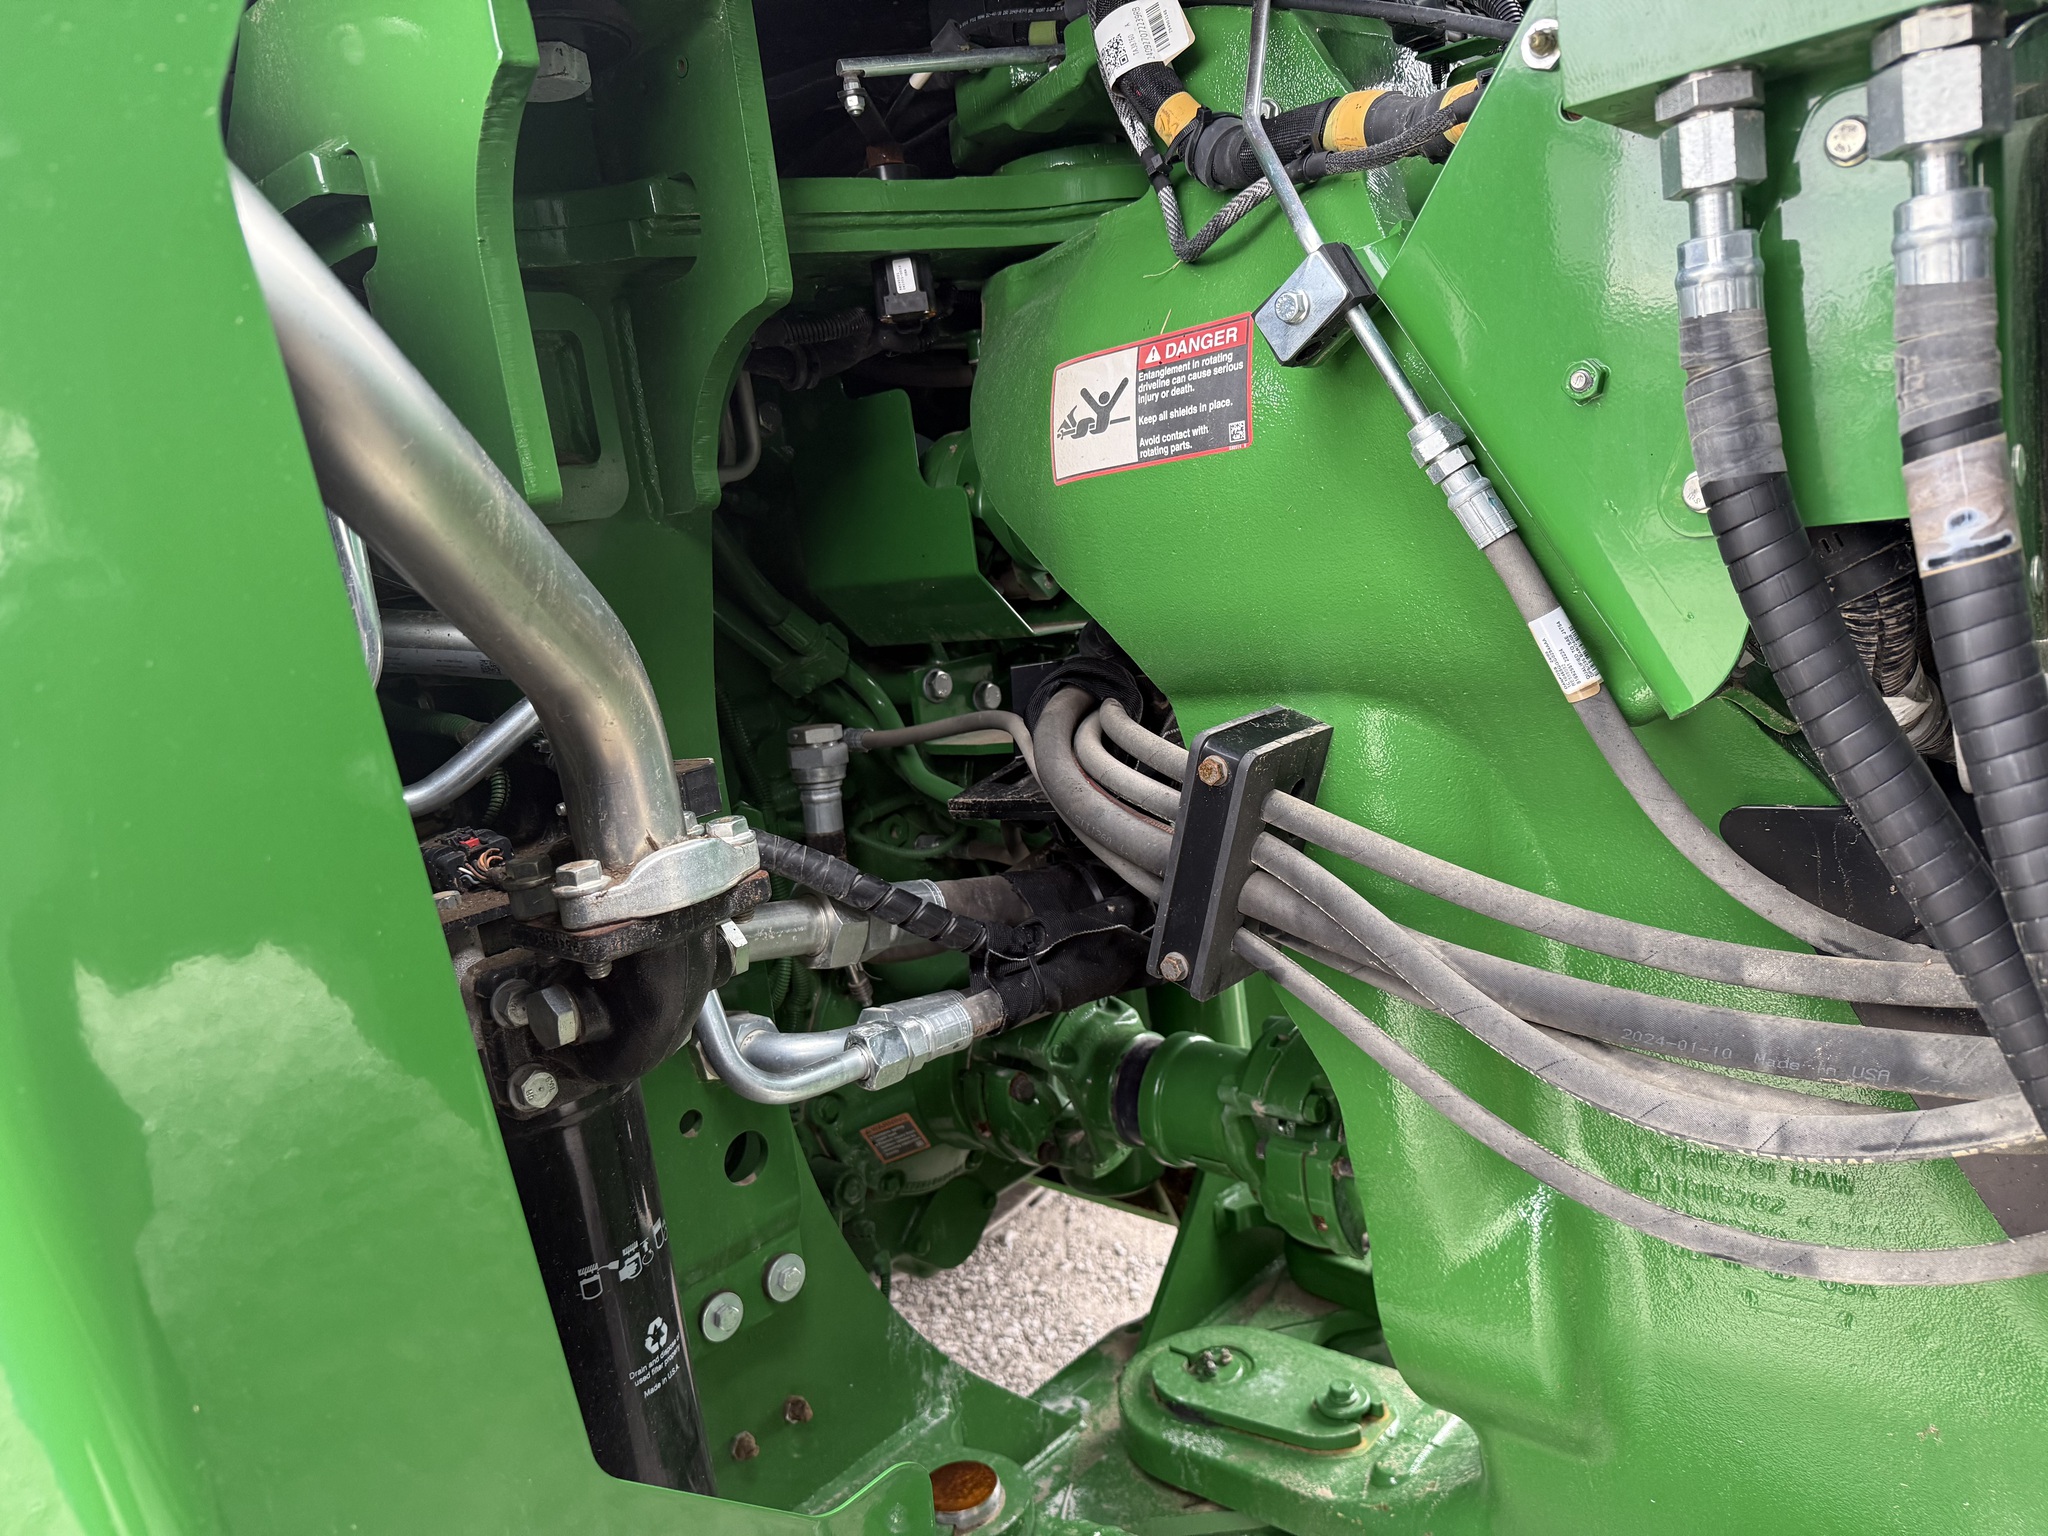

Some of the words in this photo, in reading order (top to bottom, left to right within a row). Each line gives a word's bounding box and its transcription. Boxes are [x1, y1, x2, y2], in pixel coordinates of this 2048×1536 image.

[1165, 327, 1237, 359] DANGER
[1138, 362, 1190, 382] Entanglement
[1192, 360, 1200, 370] in
[1201, 352, 1233, 369] rotating
[1138, 377, 1170, 393] driveline
[1172, 375, 1186, 387] can
[1187, 369, 1211, 382] cause
[1213, 361, 1243, 377] serious
[1138, 391, 1159, 404] injury
[1160, 390, 1168, 399] or
[1171, 384, 1195, 397] death.
[1138, 414, 1157, 425] Keep
[1159, 409, 1168, 421] all
[1169, 405, 1198, 419] shields
[1199, 402, 1207, 413] in
[1209, 398, 1233, 412] place.
[1139, 434, 1160, 447] Avoid
[1162, 429, 1190, 444] contact
[1192, 425, 1209, 438] with
[1139, 444, 1169, 459] rotating
[1170, 440, 1192, 455] parts.
[1574, 653, 1590, 680] QUALIFIED
[1621, 1028, 1732, 1060] 2024-01-10
[1754, 1052, 1800, 1072] Made
[1851, 1064, 1892, 1083] USA
[1790, 1166, 1855, 1196] RAW
[629, 1366, 647, 1379] Drain
[648, 1355, 659, 1368] and
[660, 1339, 676, 1358] dispose
[635, 1372, 651, 1386] used
[651, 1362, 664, 1375] filter
[644, 1382, 661, 1398] Made
[662, 1377, 667, 1385] in
